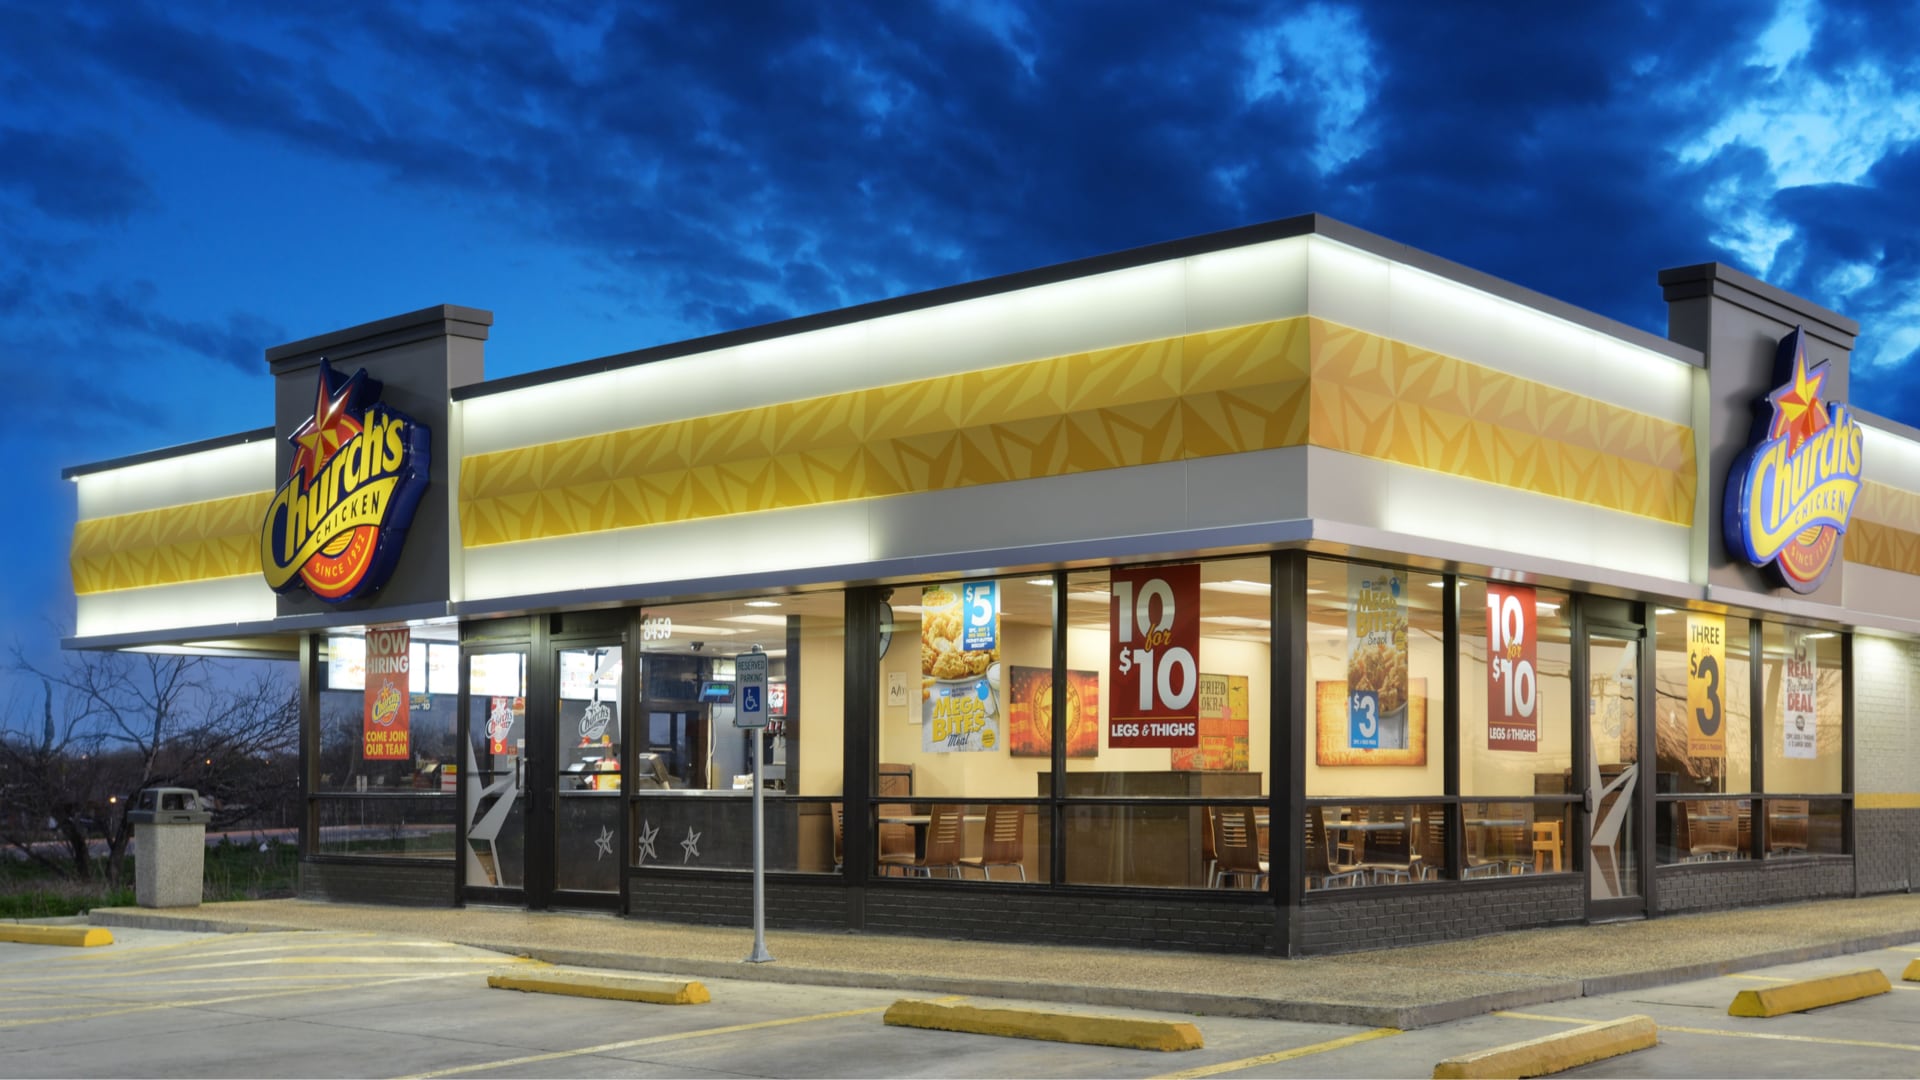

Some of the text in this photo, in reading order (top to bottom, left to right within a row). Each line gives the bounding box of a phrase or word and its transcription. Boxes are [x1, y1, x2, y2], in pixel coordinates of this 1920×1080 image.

[1750, 407, 1862, 560] Church's
[261, 409, 404, 587] Church's
[1794, 494, 1846, 525] CHICKEN
[316, 489, 381, 543] CHICKEN
[315, 534, 366, 578] SINCE 1952
[1791, 544, 1813, 567] SINCE
[965, 585, 993, 627] $5
[1112, 578, 1175, 644] 10
[643, 617, 672, 641] 8459
[1488, 594, 1524, 652] 10
[1691, 624, 1720, 645] THREE
[366, 631, 409, 657] NOW
[1144, 623, 1172, 652] for
[1507, 637, 1521, 664] for
[366, 655, 409, 674] HIRING
[738, 659, 765, 671] RESERVED
[1787, 657, 1814, 680] REAL
[739, 673, 763, 683] PARKING
[1118, 646, 1197, 711] $10
[1200, 680, 1226, 695] FRIED
[1492, 656, 1536, 717] $10
[1201, 697, 1225, 711] OKRA
[1690, 650, 1721, 737] $3
[1787, 693, 1814, 713] DEAL
[933, 696, 985, 718] MEGA
[1353, 692, 1377, 738] $3
[366, 730, 407, 742] COME JOIN
[932, 712, 986, 743] BITES
[947, 731, 971, 748] Meal
[1111, 722, 1196, 737] LEGS & THIGHS
[1489, 727, 1536, 742] LEGS & THIGHS
[366, 742, 408, 755] OUR TEAM
